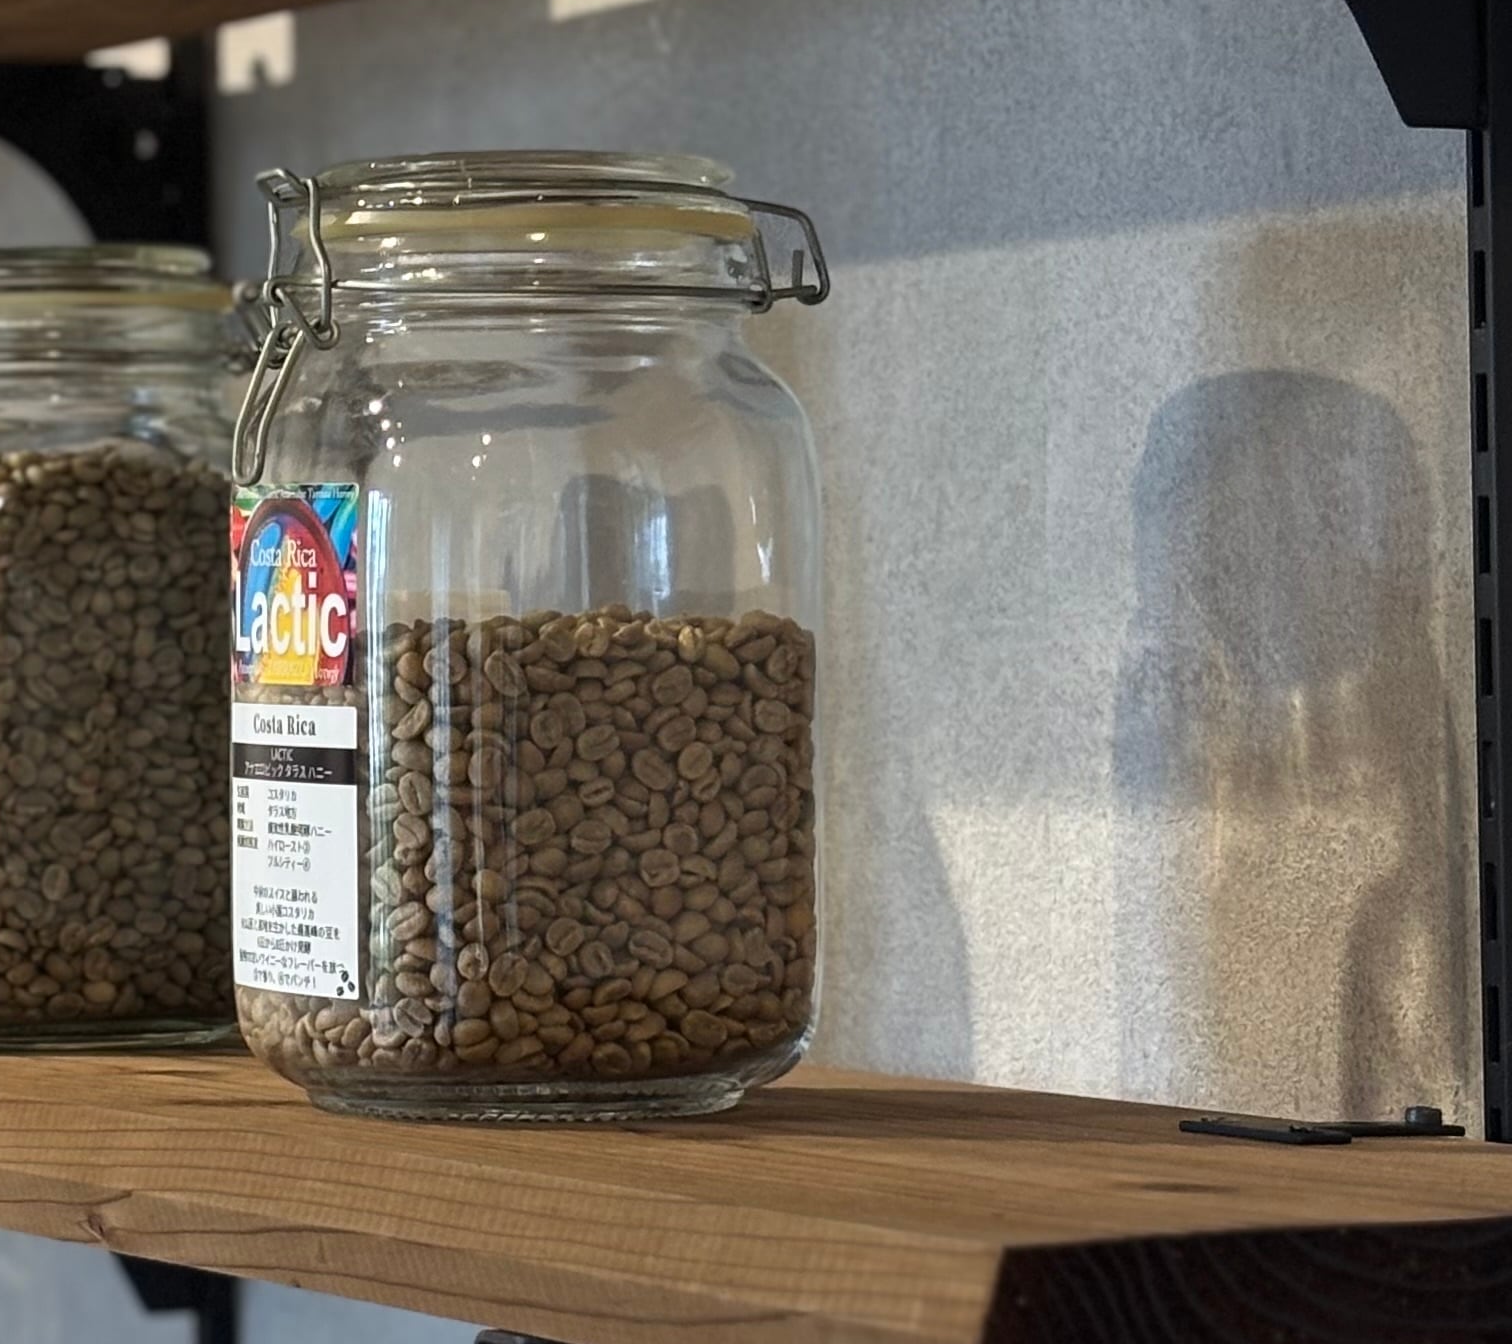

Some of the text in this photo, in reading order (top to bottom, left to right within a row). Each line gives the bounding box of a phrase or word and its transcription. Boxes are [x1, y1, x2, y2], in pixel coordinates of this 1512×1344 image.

[250, 538, 317, 568] Costa Rica
[235, 570, 348, 658] Lactic
[253, 713, 316, 736] Costa Rica
[267, 788, 297, 801] コスタリカ
